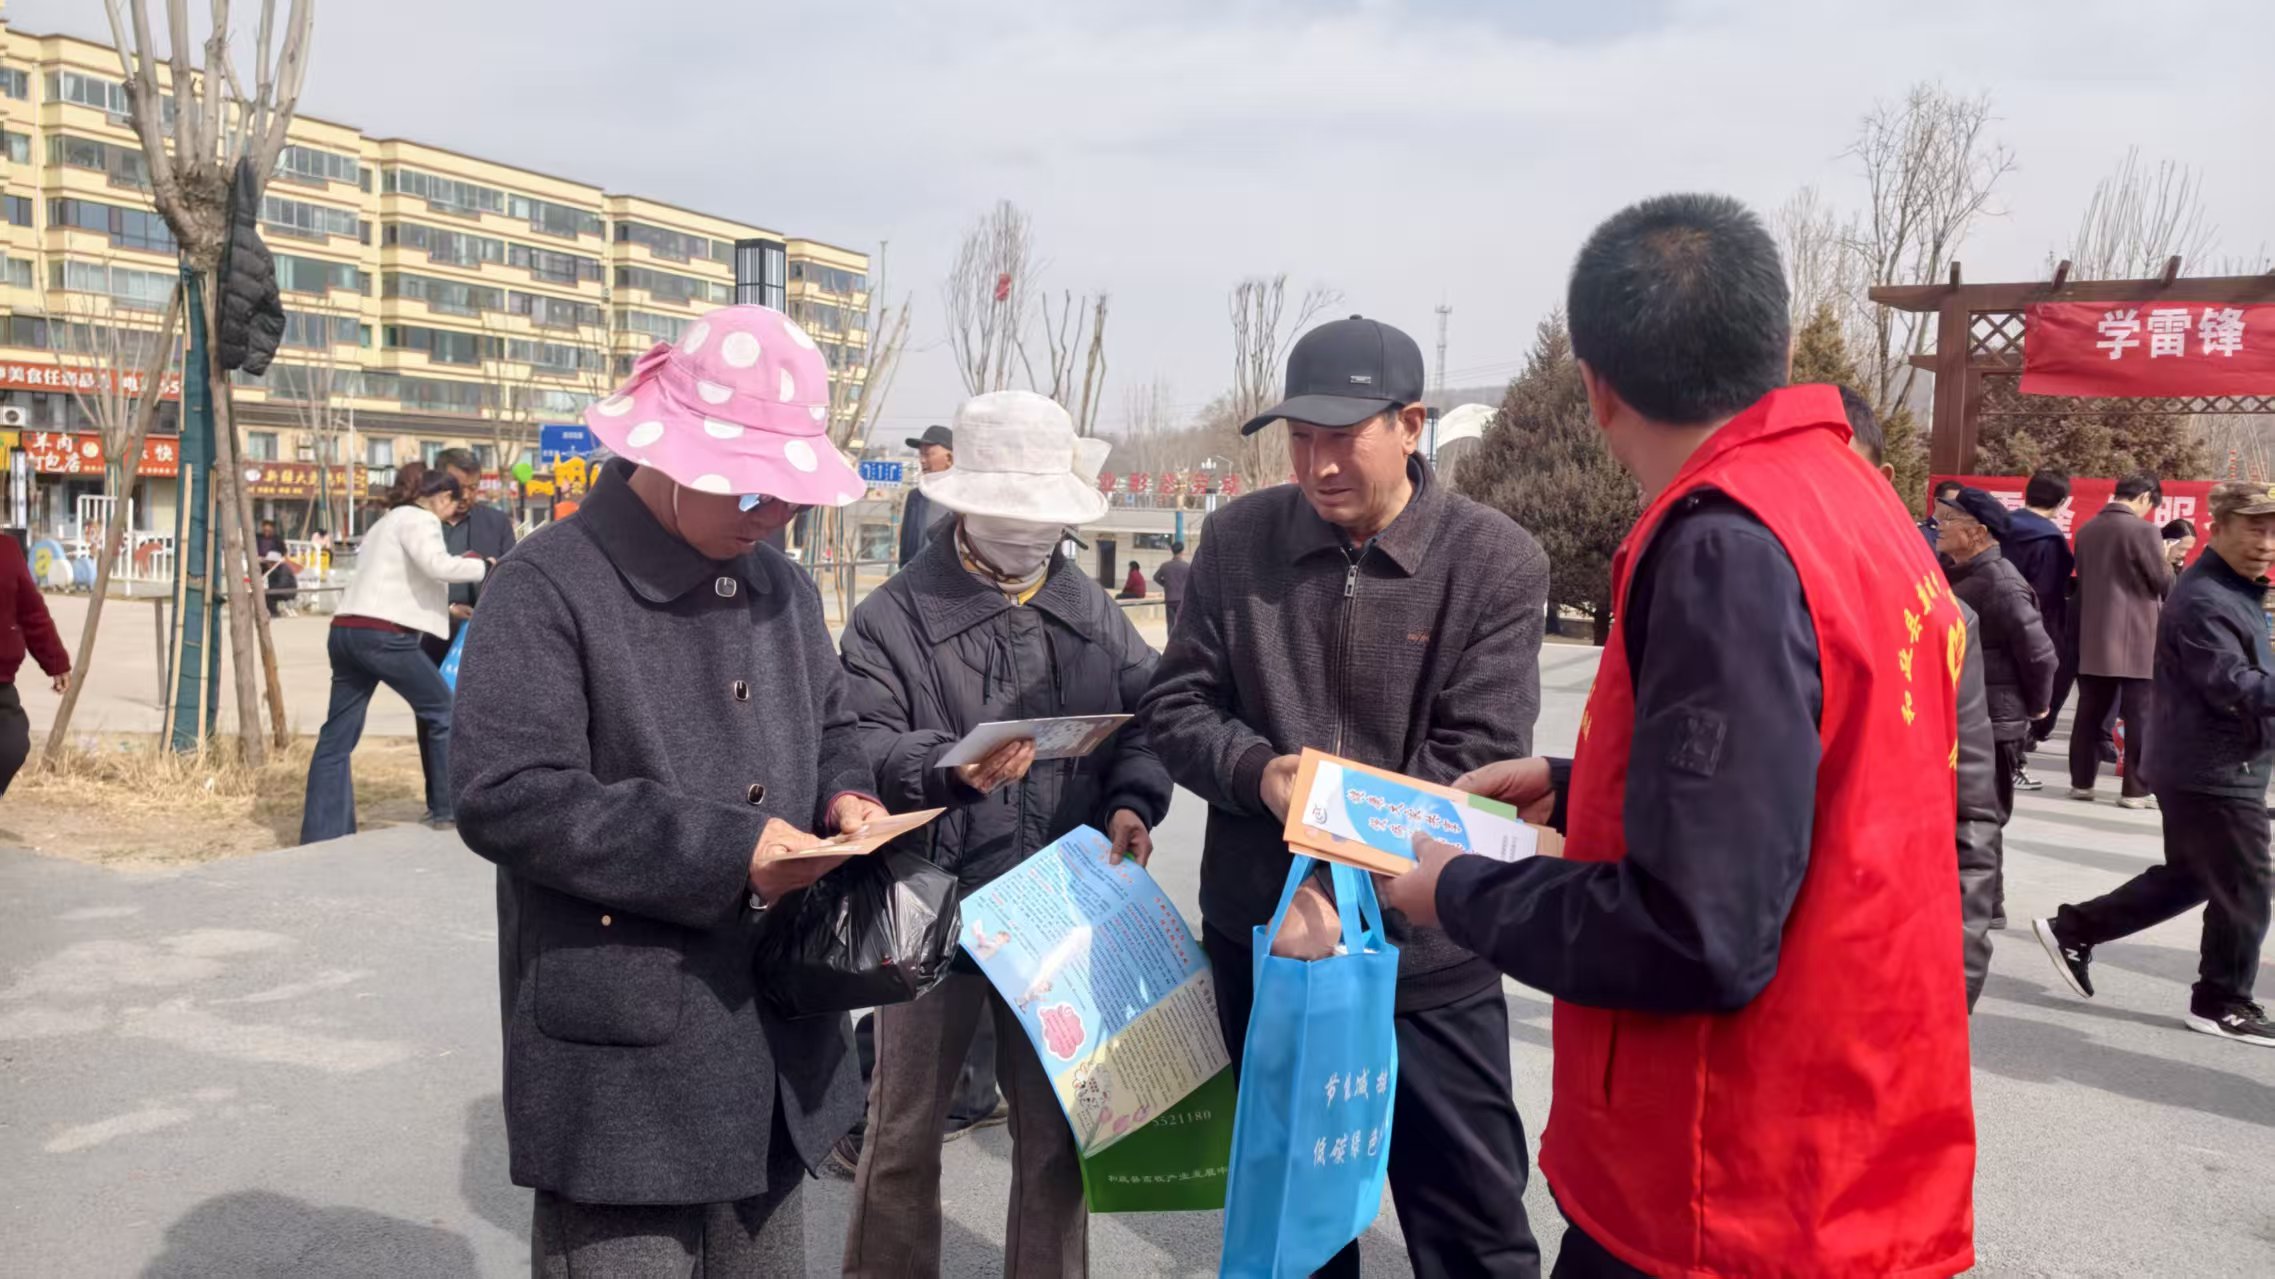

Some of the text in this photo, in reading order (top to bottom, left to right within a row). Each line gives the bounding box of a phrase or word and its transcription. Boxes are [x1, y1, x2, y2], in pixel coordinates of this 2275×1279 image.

[2096, 307, 2246, 360] 学雷锋
[32, 432, 73, 453] 羊肉
[2065, 947, 2081, 962] N
[2221, 1013, 2246, 1026] N
[1313, 1126, 1384, 1168] 低碳绿色
